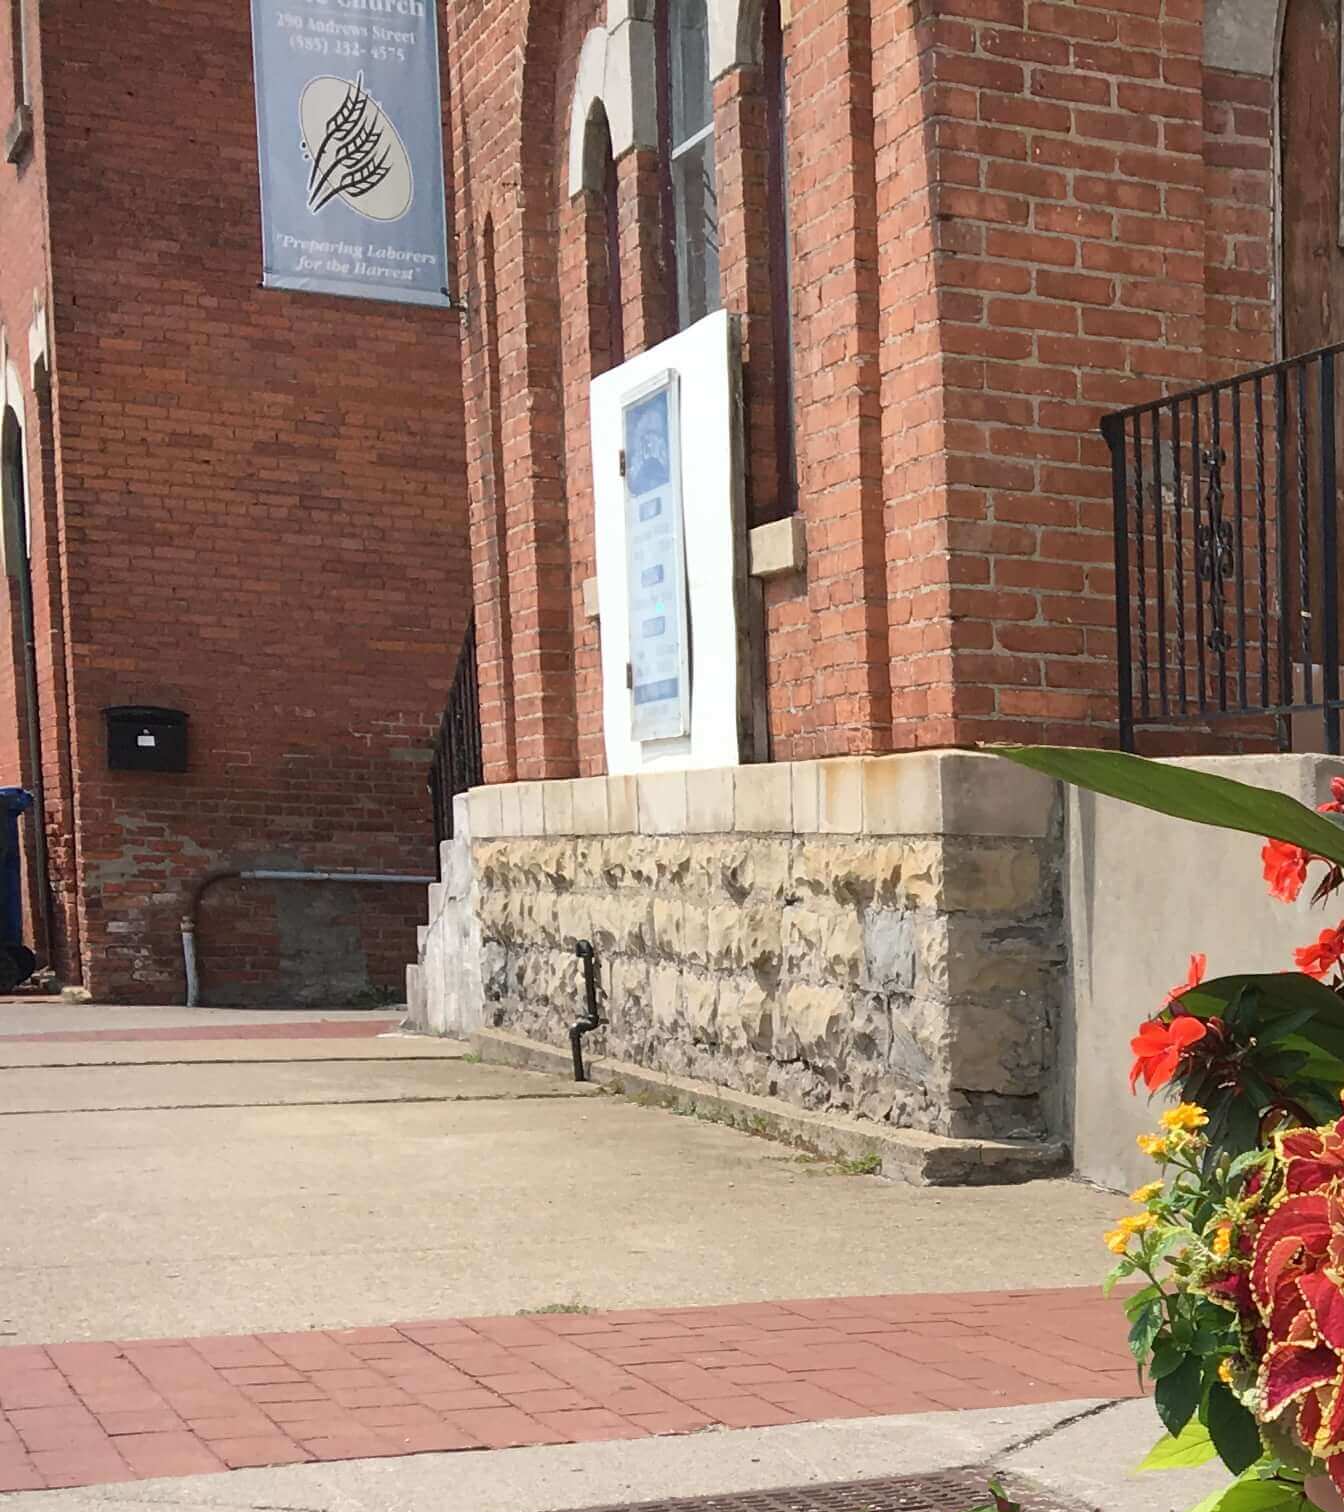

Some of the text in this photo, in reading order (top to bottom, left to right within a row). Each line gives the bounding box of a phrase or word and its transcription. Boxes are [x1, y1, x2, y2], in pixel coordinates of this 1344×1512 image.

[308, 17, 368, 37] Andrews
[372, 25, 417, 45] Street
[296, 256, 322, 271] for
[326, 259, 350, 273] the
[367, 244, 436, 265] Laborers
